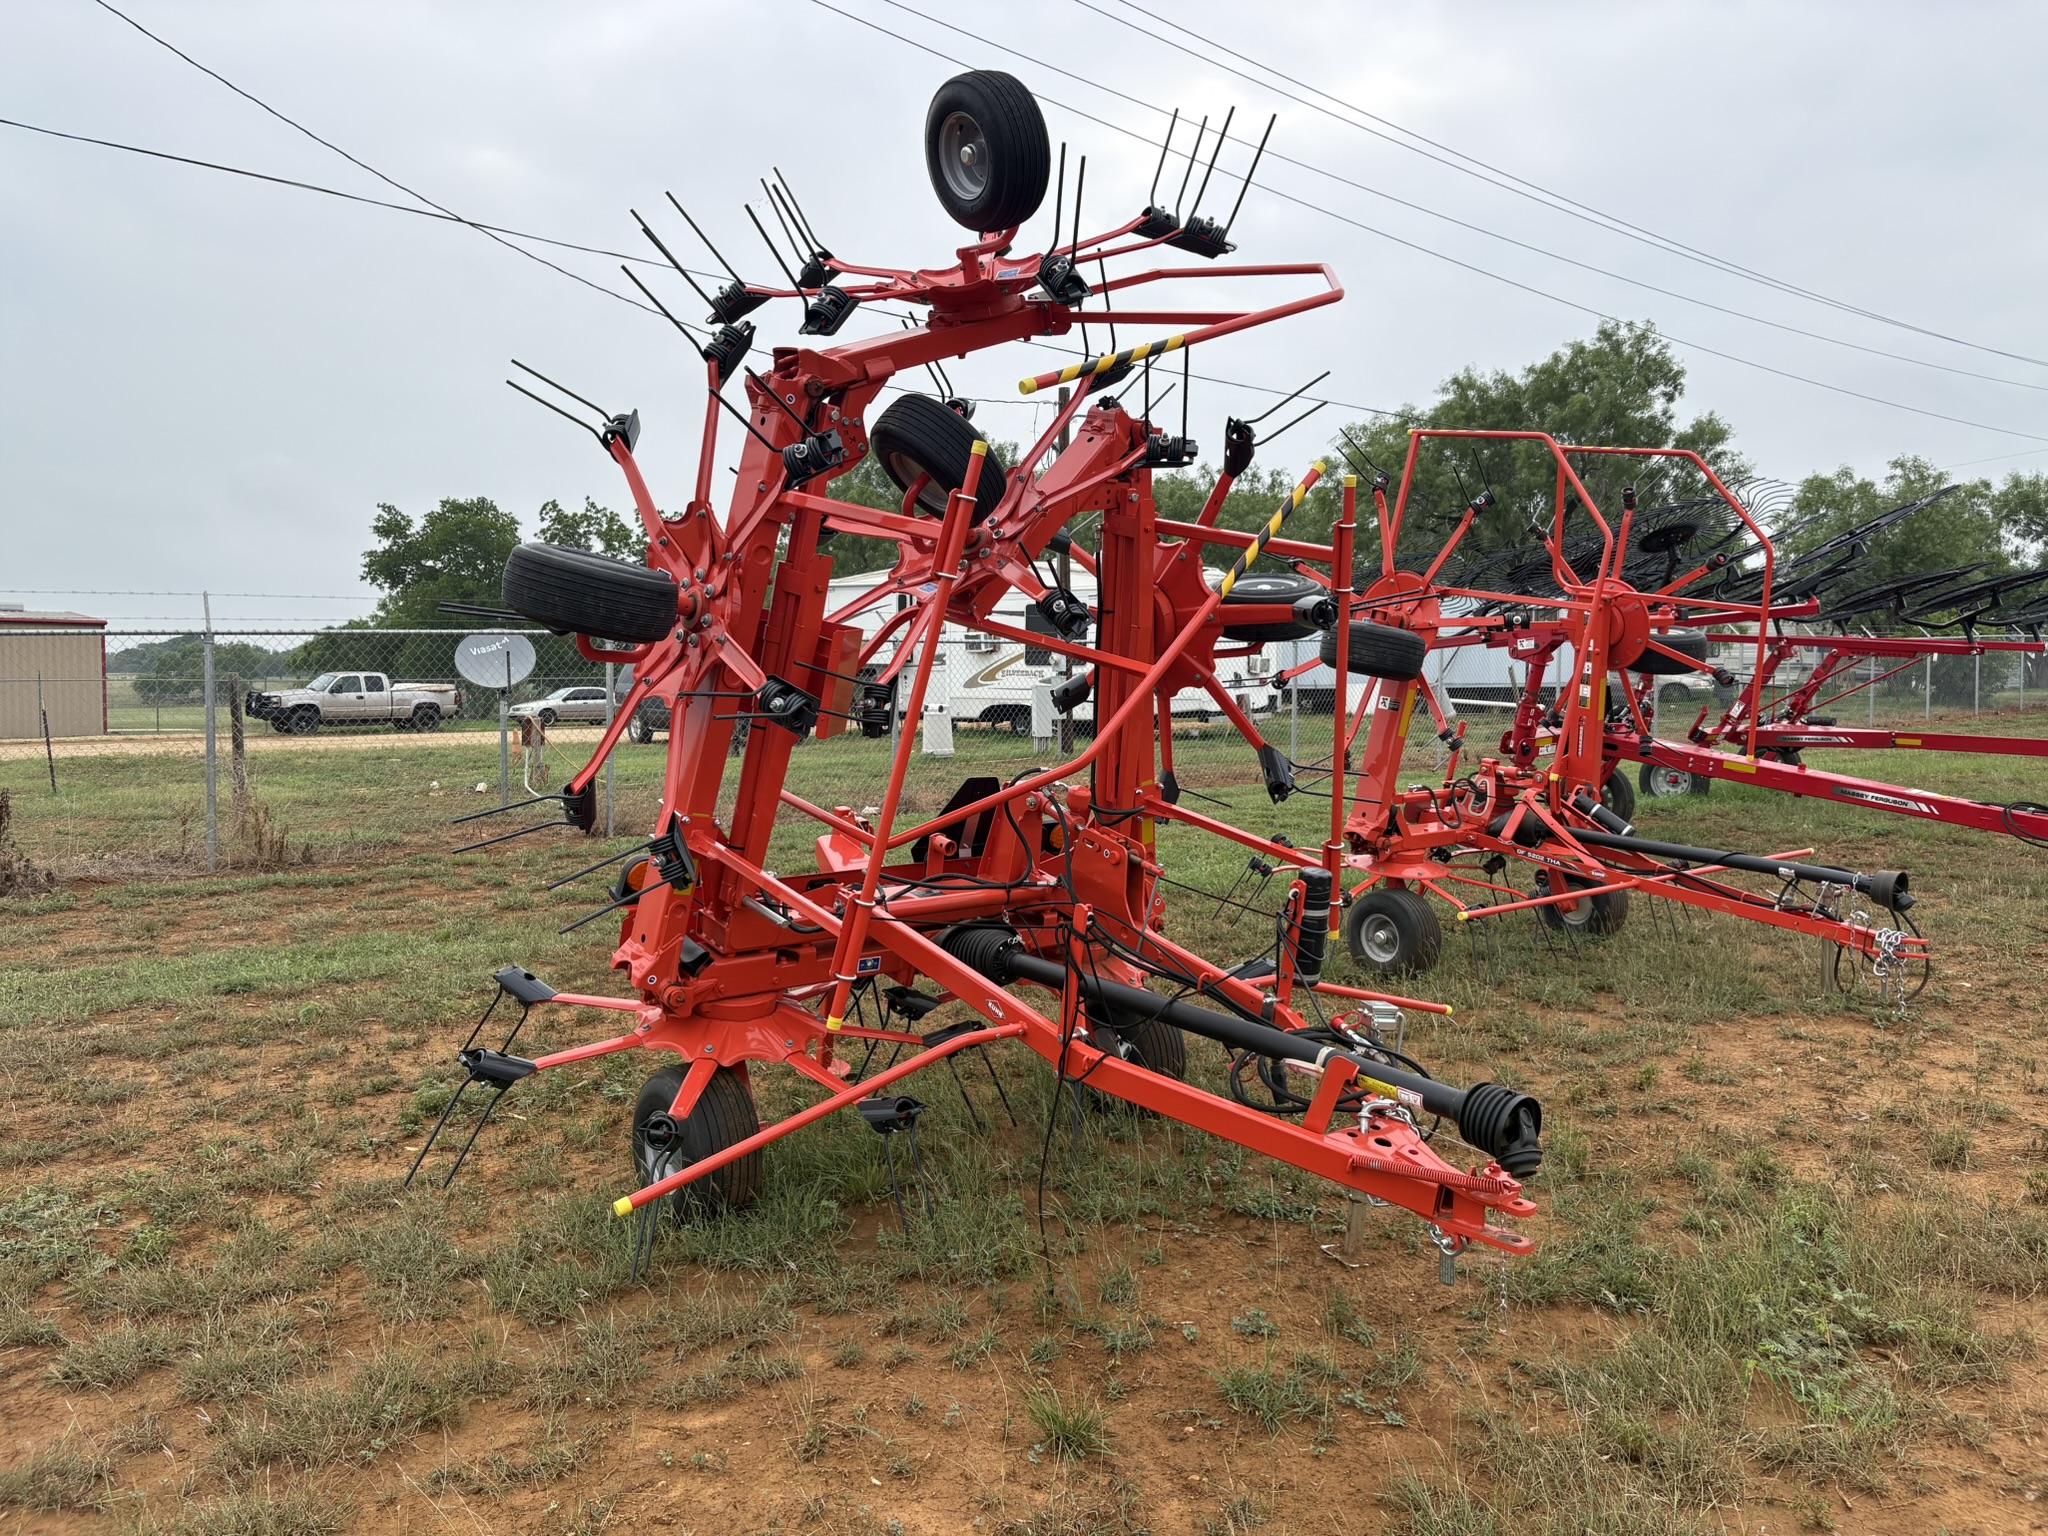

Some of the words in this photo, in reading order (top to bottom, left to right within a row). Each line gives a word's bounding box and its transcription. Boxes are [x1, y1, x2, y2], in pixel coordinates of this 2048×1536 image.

[469, 641, 503, 656] Viasat
[1001, 669, 1045, 678] SILVERBACK
[1840, 789, 1869, 799] MASSEY
[1870, 795, 1908, 807] FERGUSON
[1527, 851, 1545, 861] 5202
[1546, 856, 1561, 866] THA
[988, 1000, 1003, 1018] KUHN
